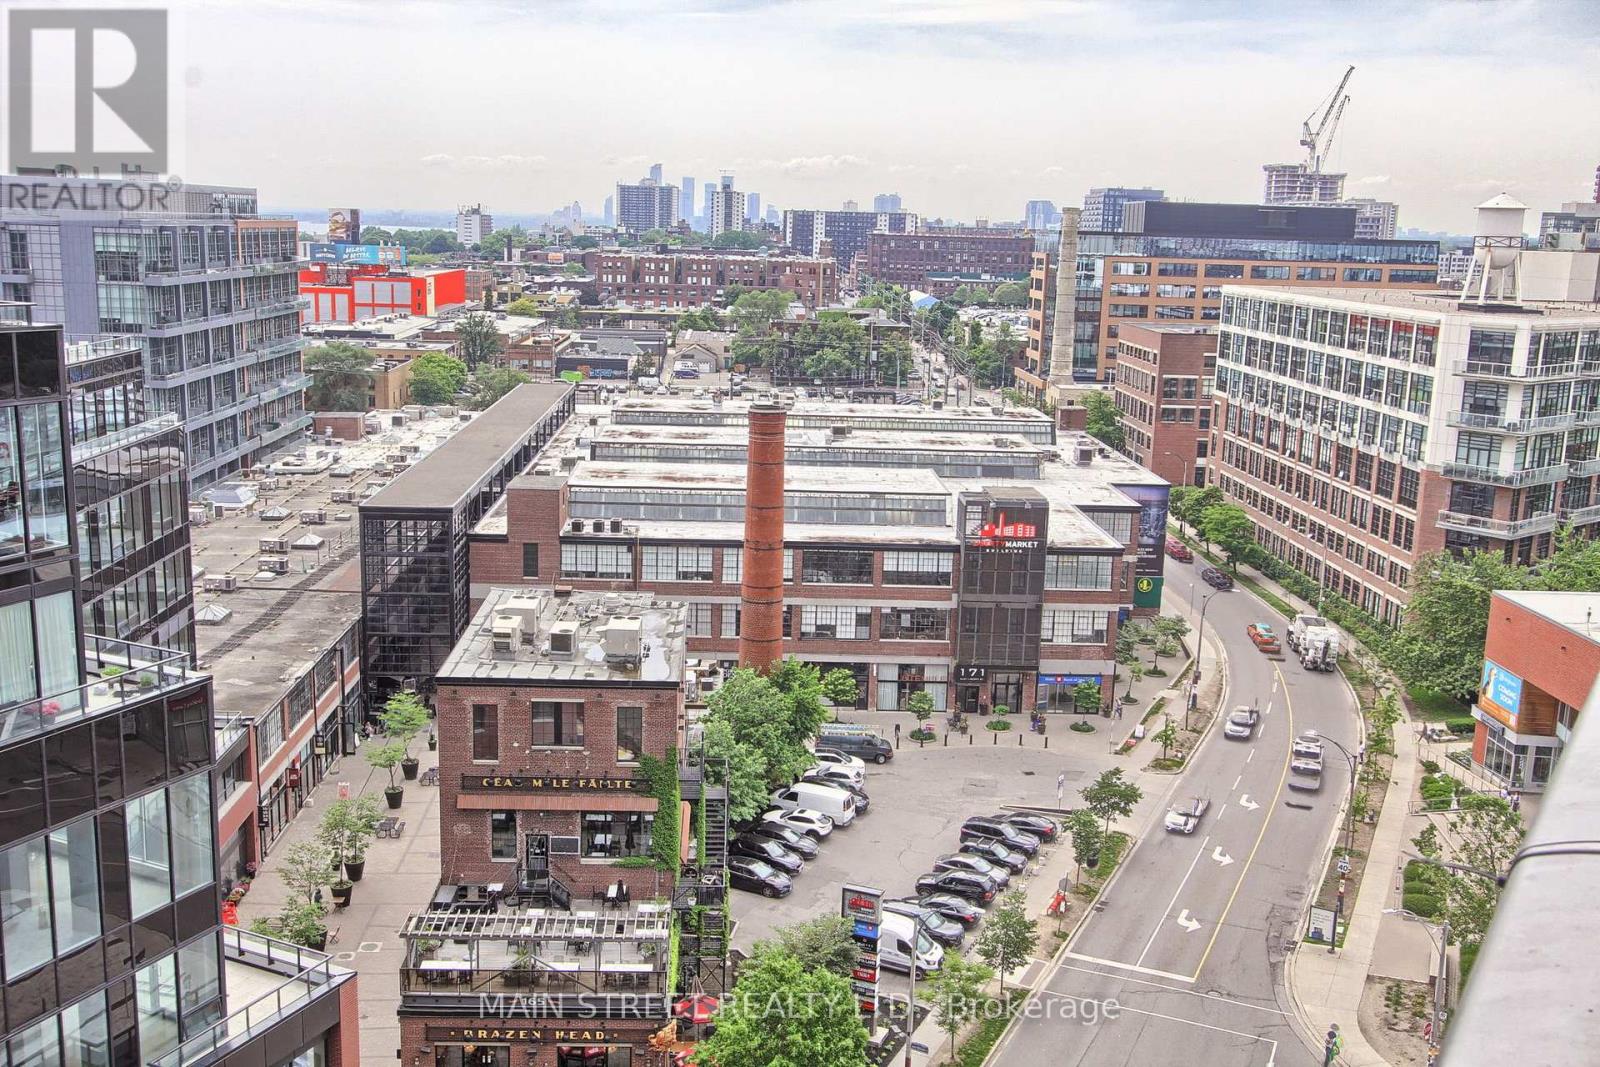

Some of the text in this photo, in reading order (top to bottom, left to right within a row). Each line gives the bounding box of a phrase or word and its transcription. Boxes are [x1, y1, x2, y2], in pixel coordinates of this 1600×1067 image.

[960, 668, 985, 677] 171
[482, 777, 523, 787] CÉA
[532, 778, 570, 788] MLE
[1338, 864, 1348, 872] 40
[555, 1030, 606, 1040] HEAD
